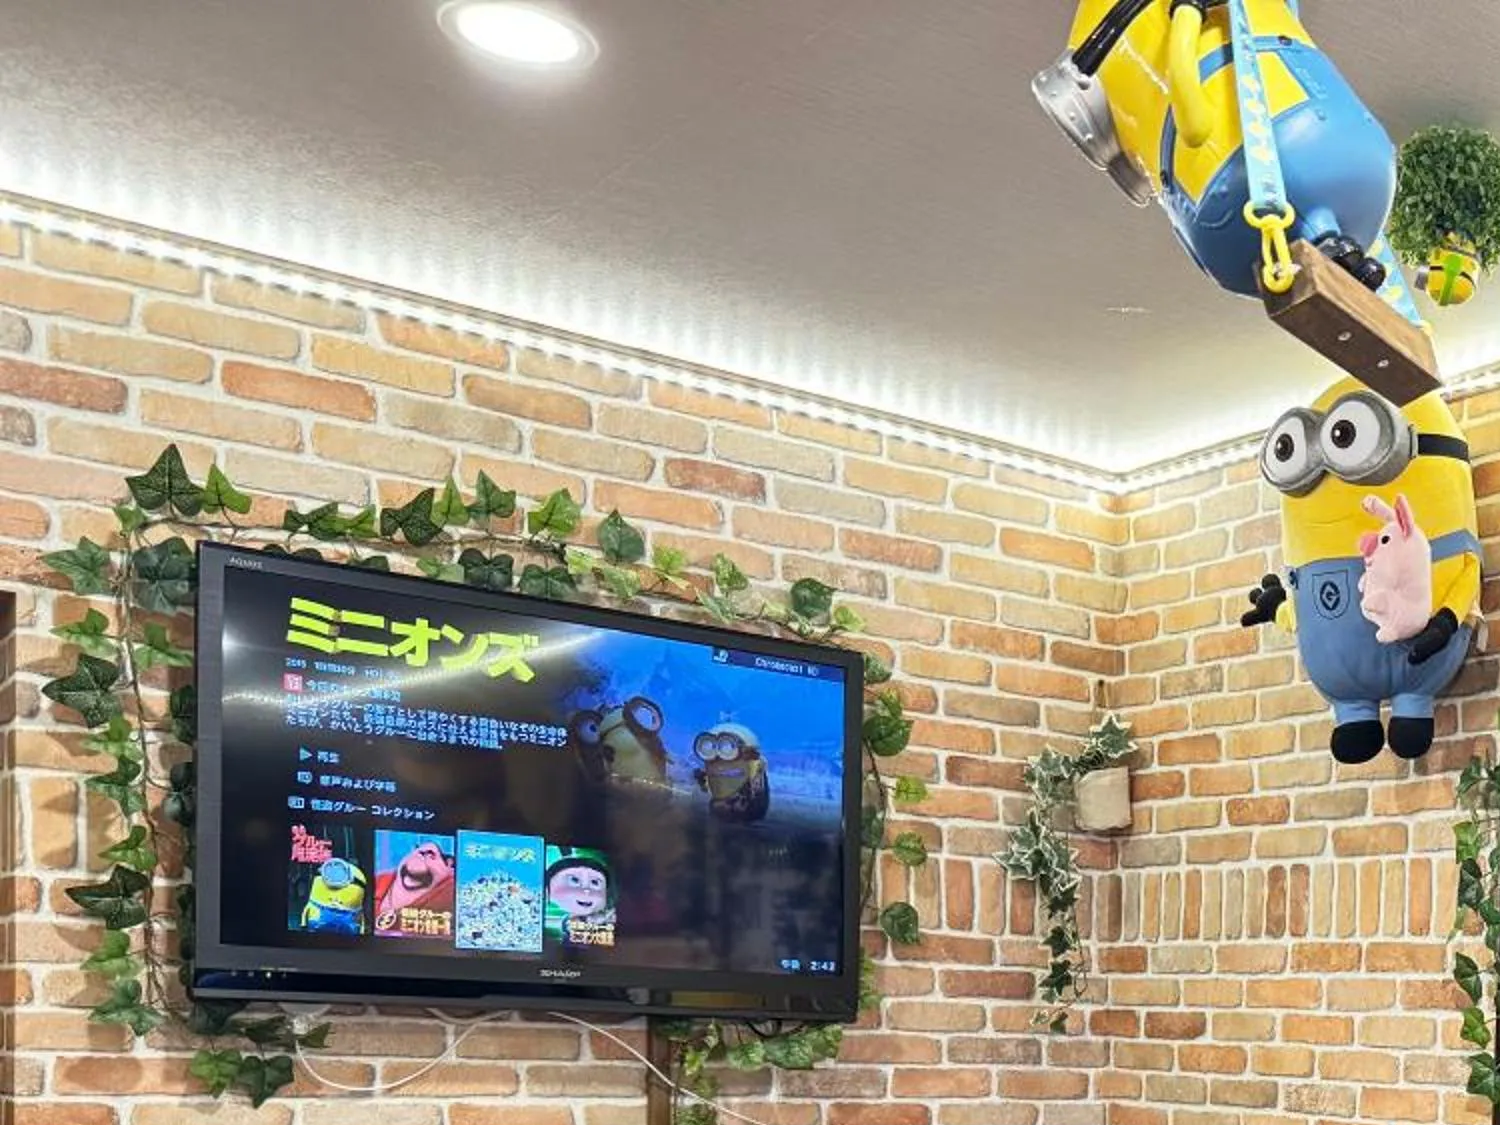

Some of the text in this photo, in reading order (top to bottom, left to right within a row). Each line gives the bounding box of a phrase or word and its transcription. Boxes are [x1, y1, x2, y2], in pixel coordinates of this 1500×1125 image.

[286, 597, 540, 683] ミニオンズ
